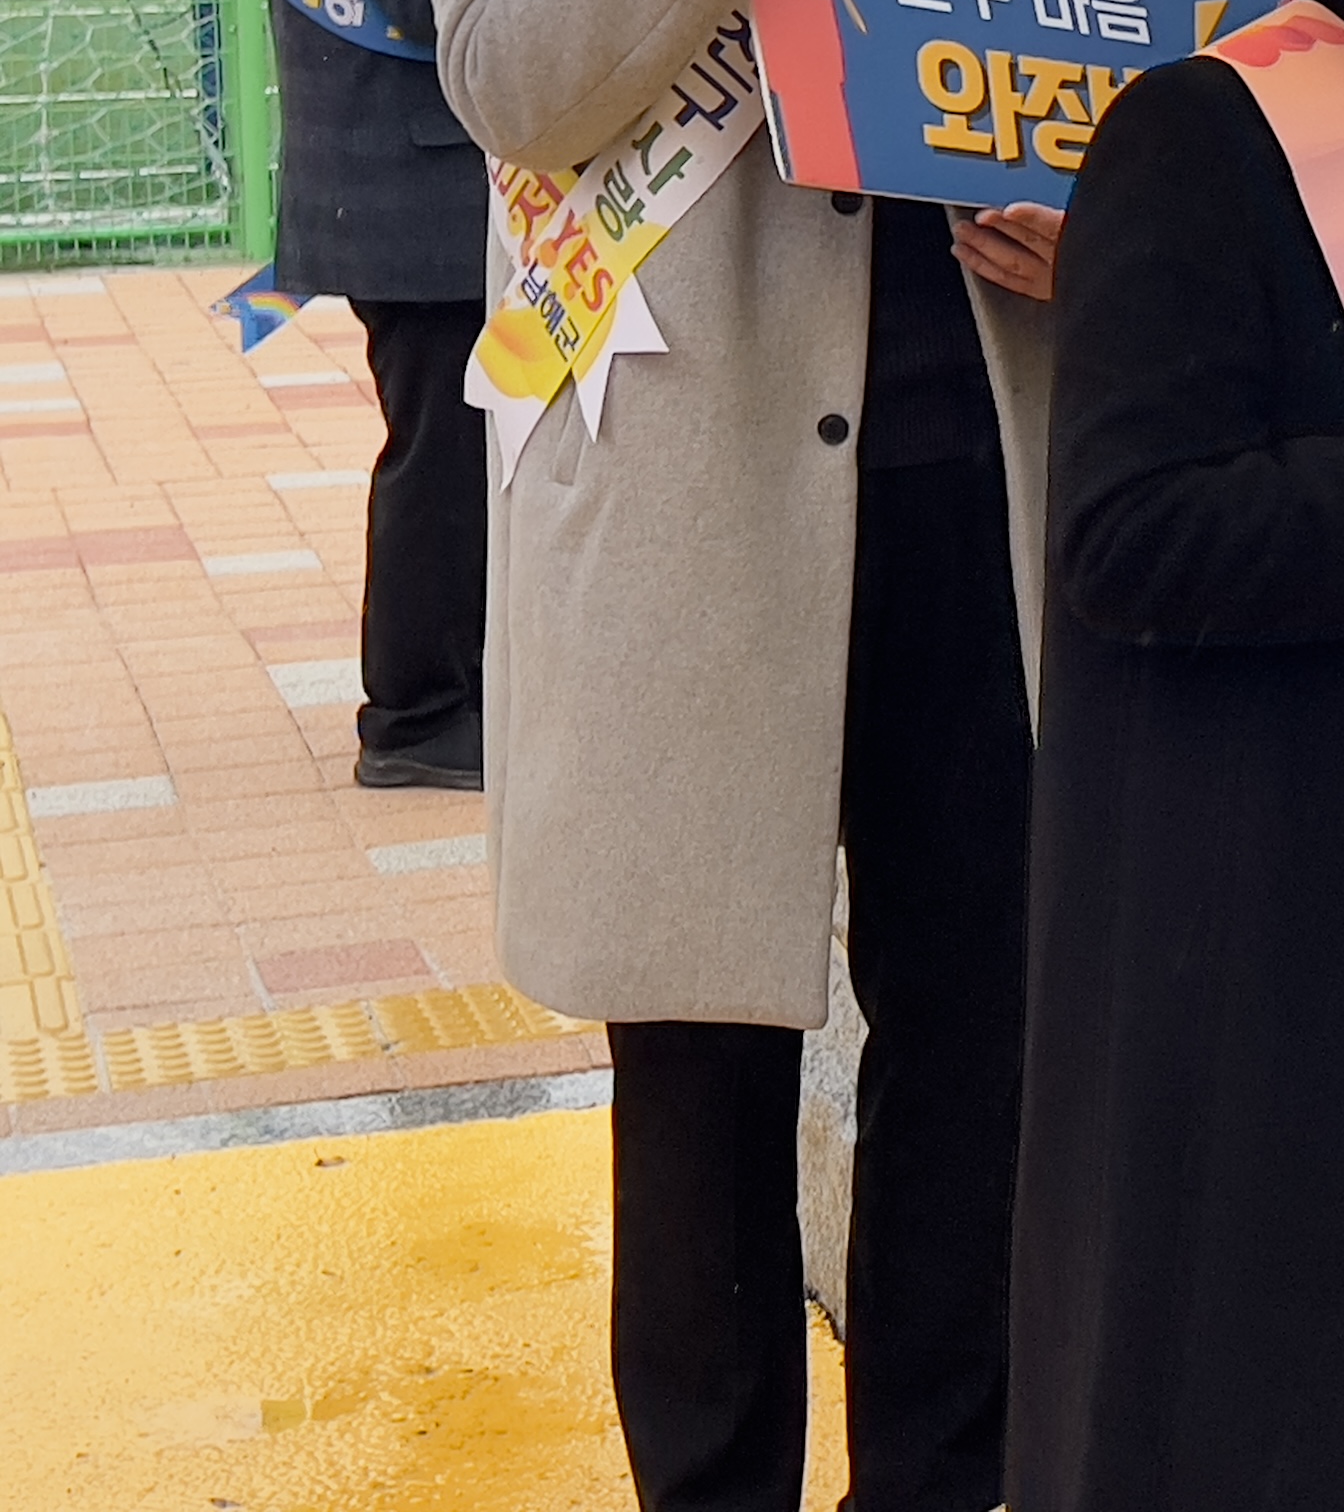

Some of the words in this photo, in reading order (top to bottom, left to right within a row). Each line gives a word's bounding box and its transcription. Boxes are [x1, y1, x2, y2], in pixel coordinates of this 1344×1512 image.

[595, 121, 693, 242] 사랑
[519, 256, 580, 364] 남해군
[551, 207, 614, 313] YES
